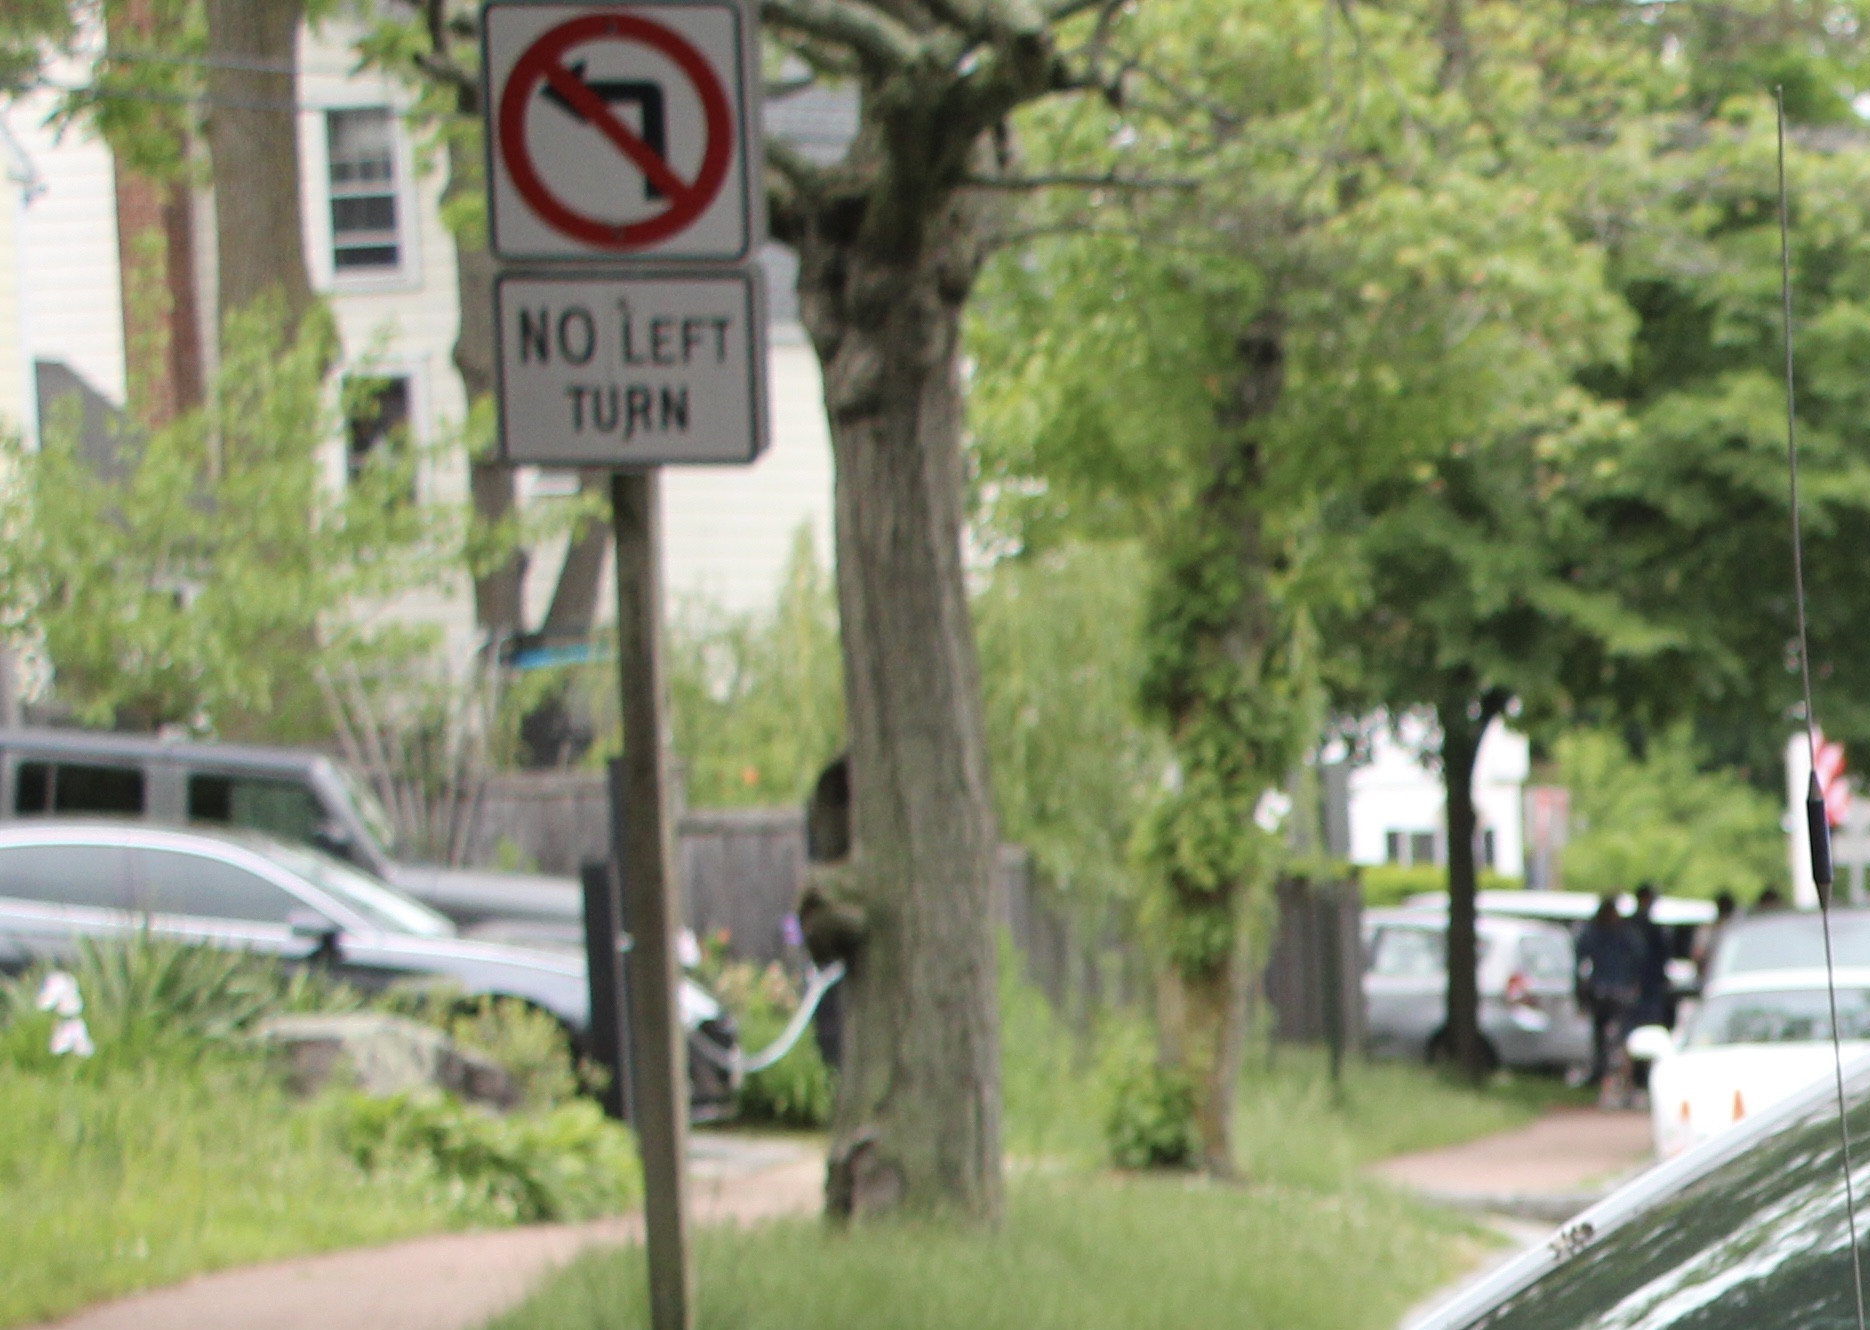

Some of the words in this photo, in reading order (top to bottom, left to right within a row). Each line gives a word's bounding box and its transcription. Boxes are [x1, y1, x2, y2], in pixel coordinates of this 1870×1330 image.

[519, 305, 597, 367] NO
[618, 307, 730, 367] LEFT
[566, 384, 690, 438] TURN
